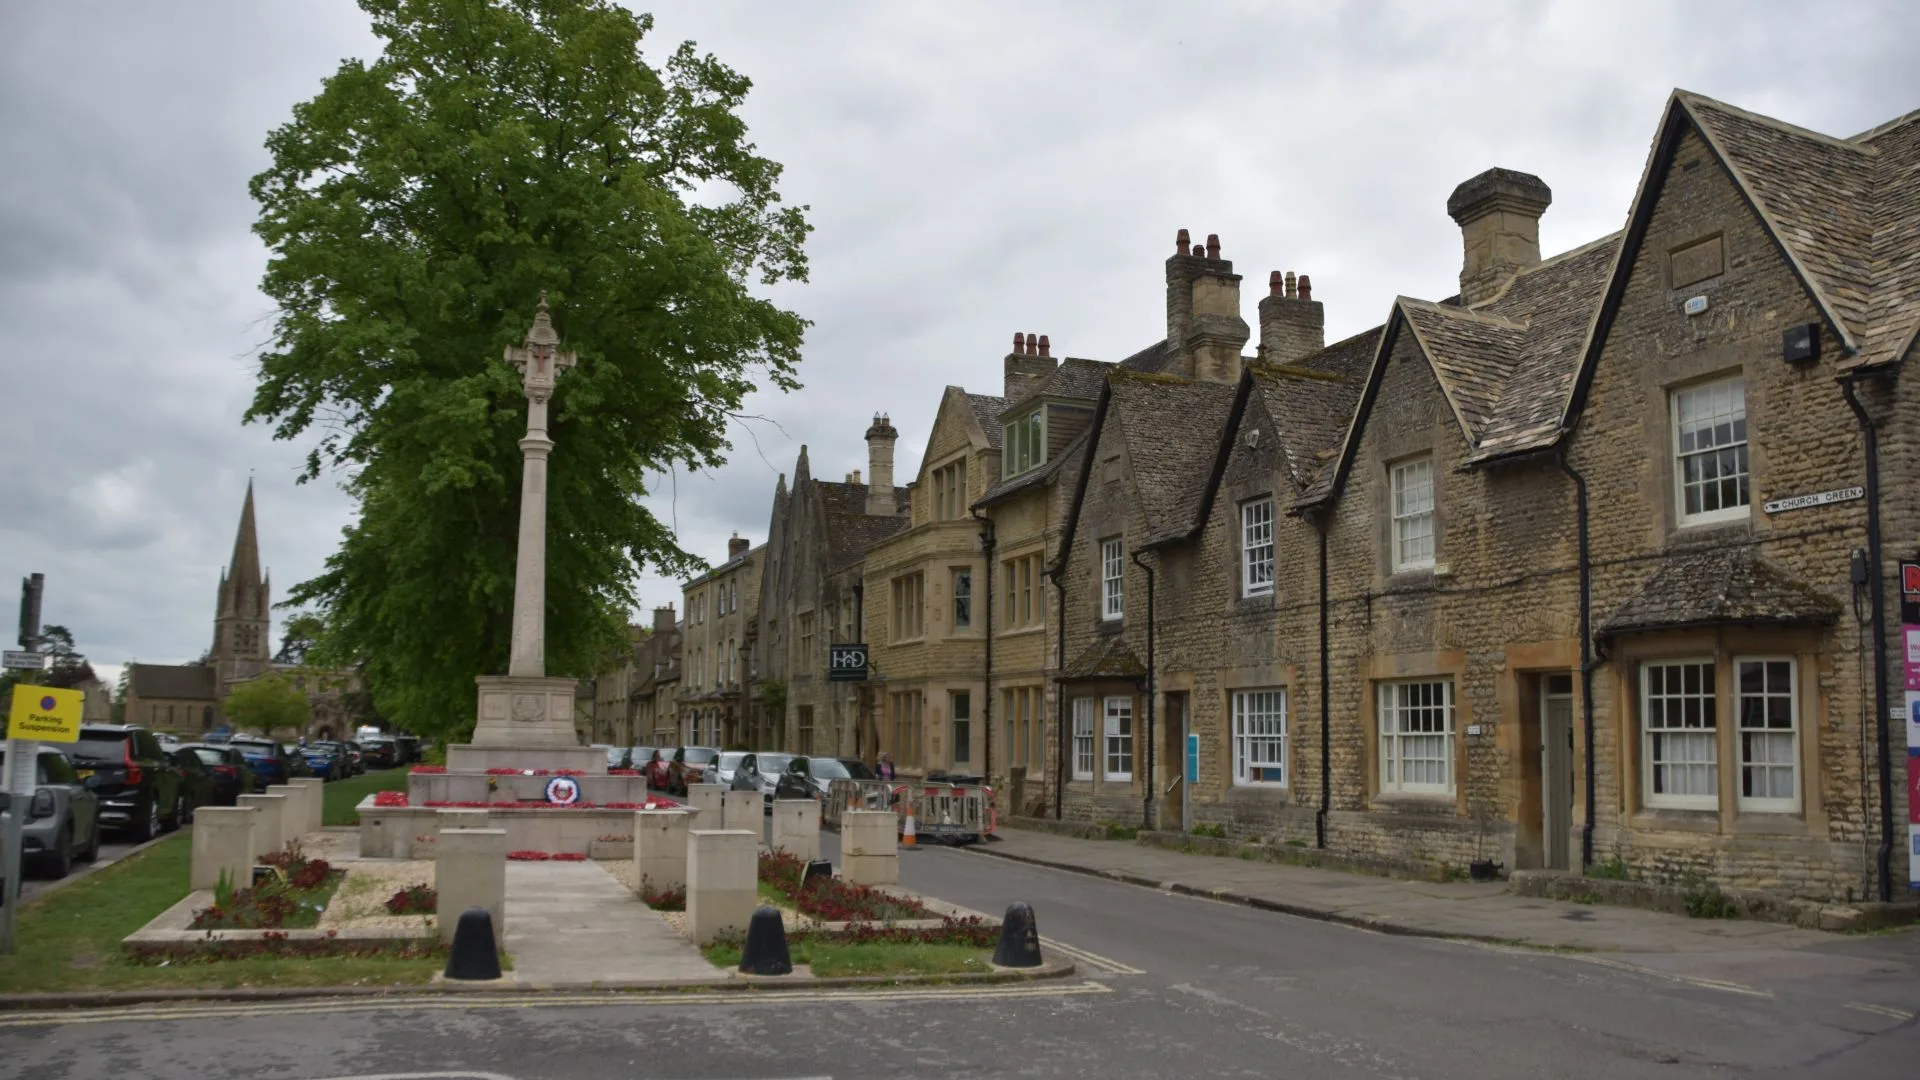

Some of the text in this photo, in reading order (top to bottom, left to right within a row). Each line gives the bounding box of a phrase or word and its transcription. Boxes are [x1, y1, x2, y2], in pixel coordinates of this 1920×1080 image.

[1781, 496, 1818, 509] CHURCH
[29, 713, 63, 725] Parking
[19, 721, 70, 733] Suspension
